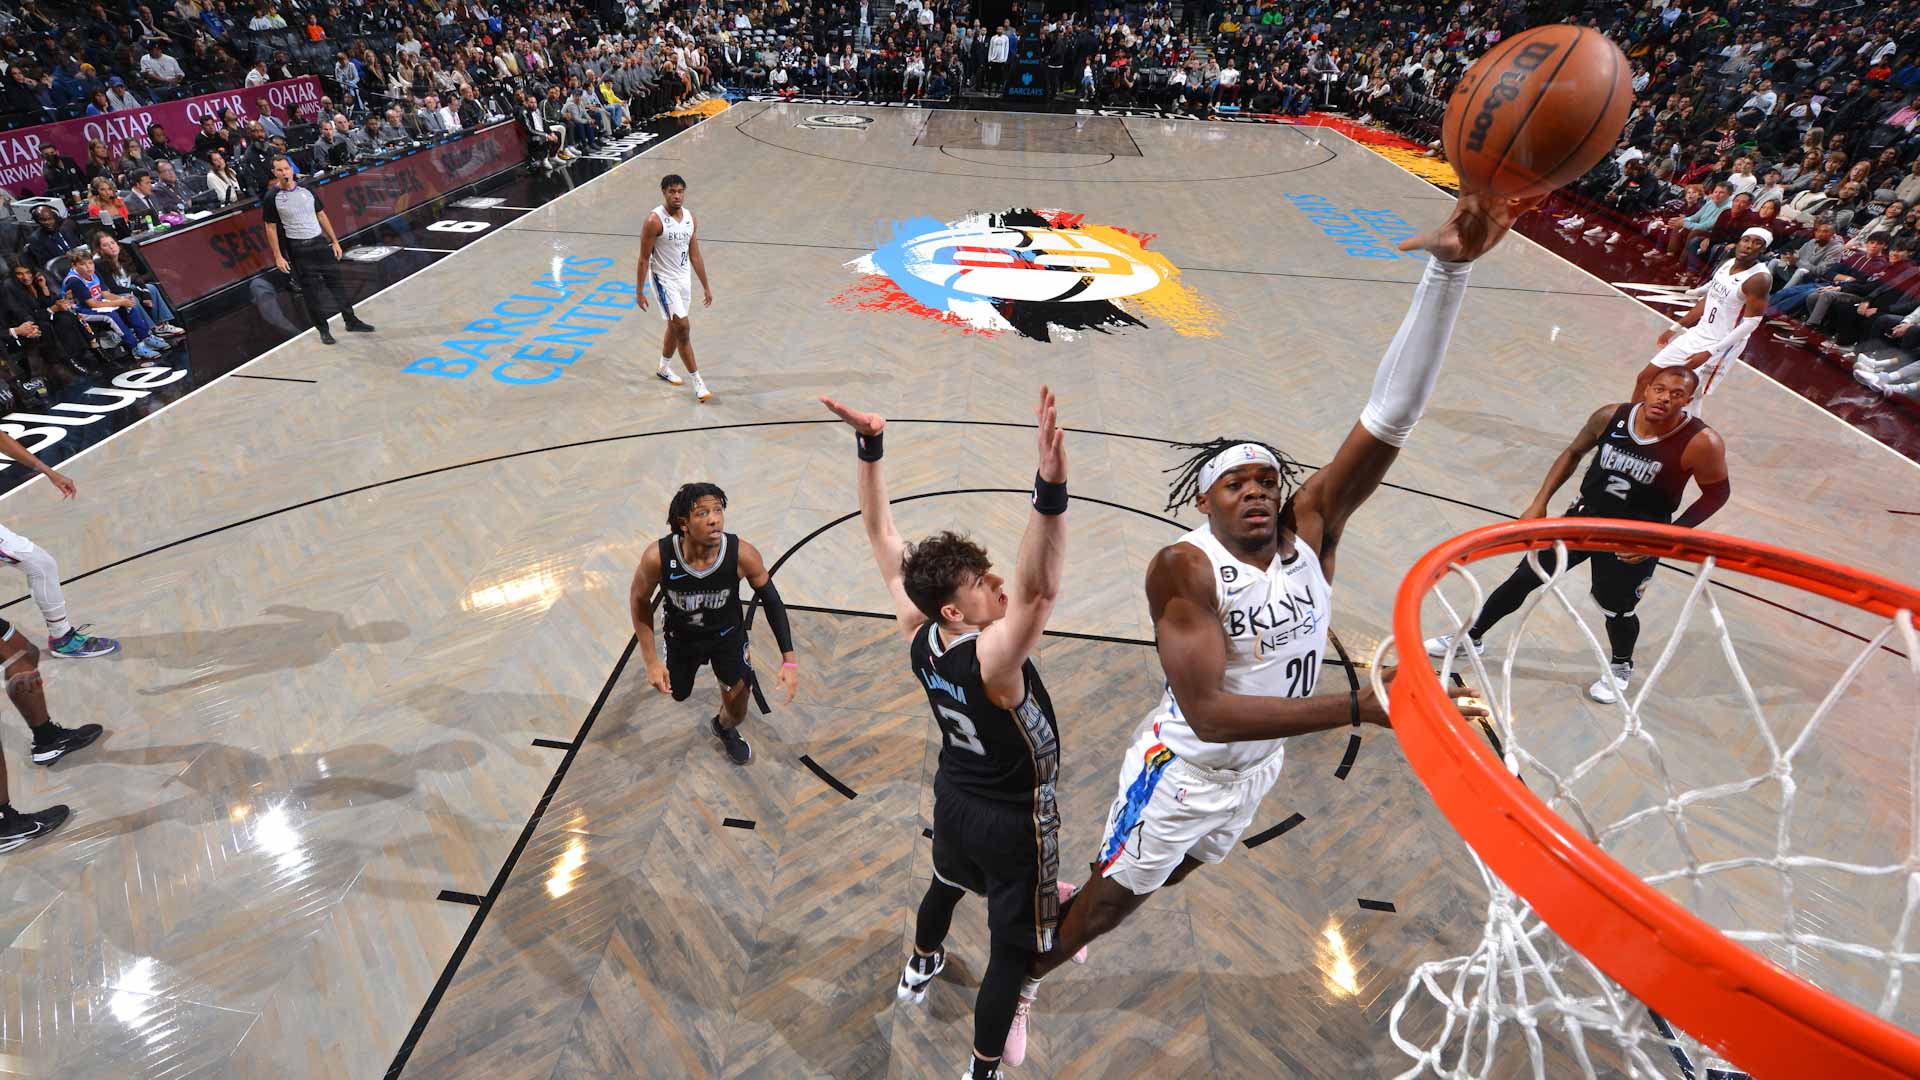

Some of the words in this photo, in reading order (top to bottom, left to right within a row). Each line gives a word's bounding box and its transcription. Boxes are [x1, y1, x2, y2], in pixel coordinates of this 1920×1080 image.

[269, 82, 317, 110] QATAR
[1008, 87, 1044, 96] BARCLAYS
[1466, 41, 1561, 152] Wilson
[187, 95, 246, 125] QATAR
[300, 101, 320, 115] WAYS
[84, 112, 152, 147] QATAR
[0, 134, 42, 168] TAR
[0, 160, 46, 186] IRWAY
[399, 256, 615, 380] BARCLAYS
[1708, 307, 1717, 324] 6
[491, 280, 651, 386] CENTER
[1617, 420, 1625, 429] 6
[1600, 443, 1663, 485] MEMPHIS
[1605, 475, 1632, 500] 2
[667, 589, 731, 613] MEMPHIS
[1229, 585, 1315, 637] BKLYN
[1286, 650, 1316, 698] 20
[937, 704, 985, 756] 3
